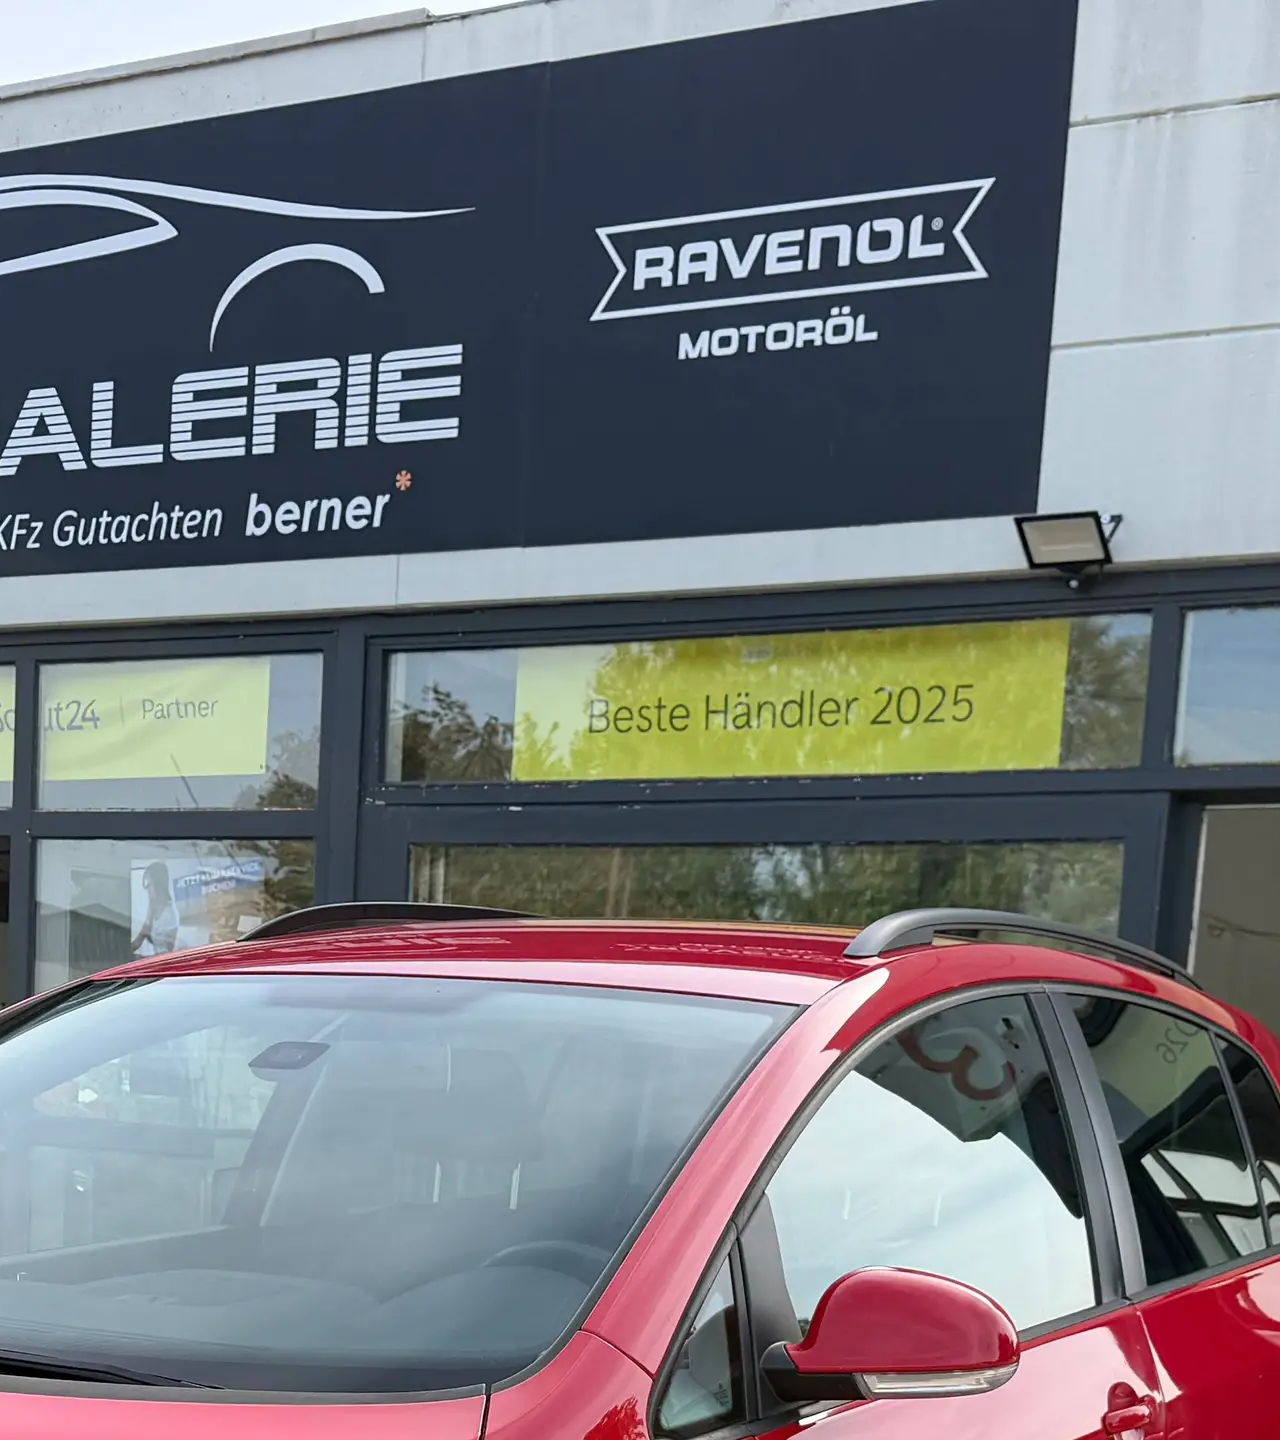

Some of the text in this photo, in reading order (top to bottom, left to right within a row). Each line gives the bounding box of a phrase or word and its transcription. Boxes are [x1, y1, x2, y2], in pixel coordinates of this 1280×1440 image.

[677, 305, 879, 360] MOTORÖL
[52, 500, 223, 547] Gutachten
[245, 493, 391, 537] berner
[141, 698, 219, 721] Partner
[587, 684, 974, 734] Beste Händler 2025
